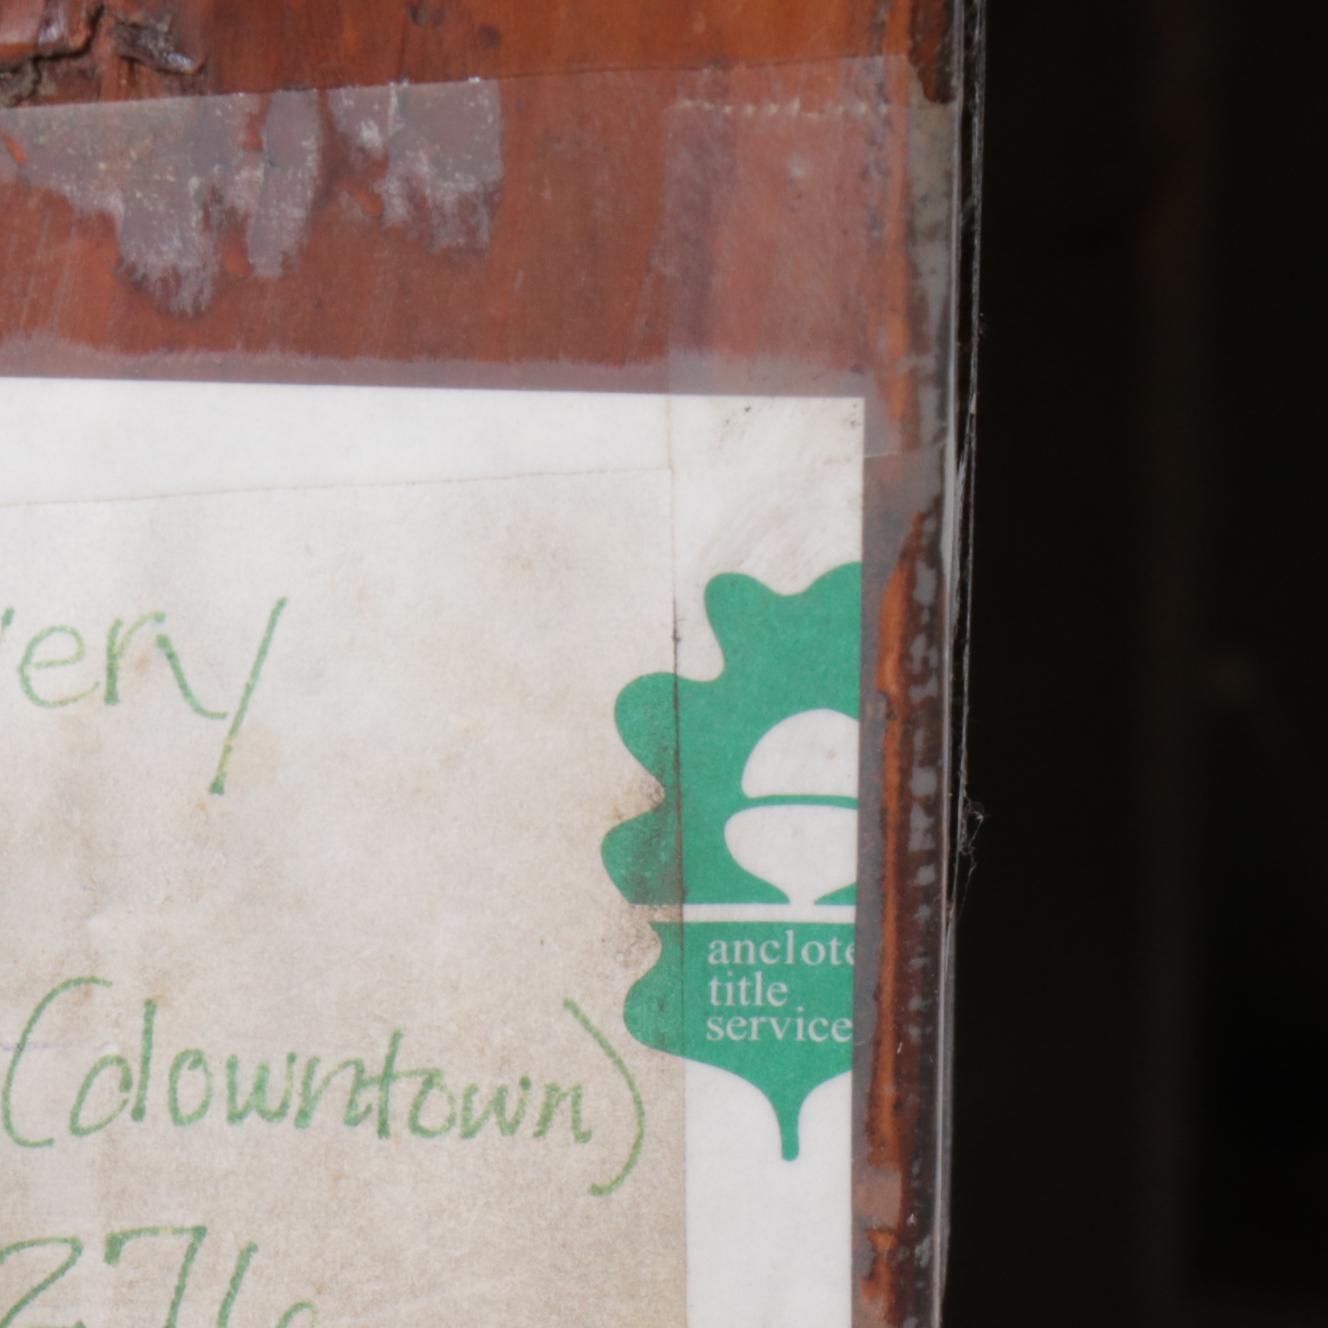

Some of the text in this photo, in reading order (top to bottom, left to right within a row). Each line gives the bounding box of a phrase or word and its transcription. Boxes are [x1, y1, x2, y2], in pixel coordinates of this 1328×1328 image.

[708, 970, 790, 1008] title
[706, 1004, 854, 1043] service
[1, 976, 646, 1196] (downtown)
